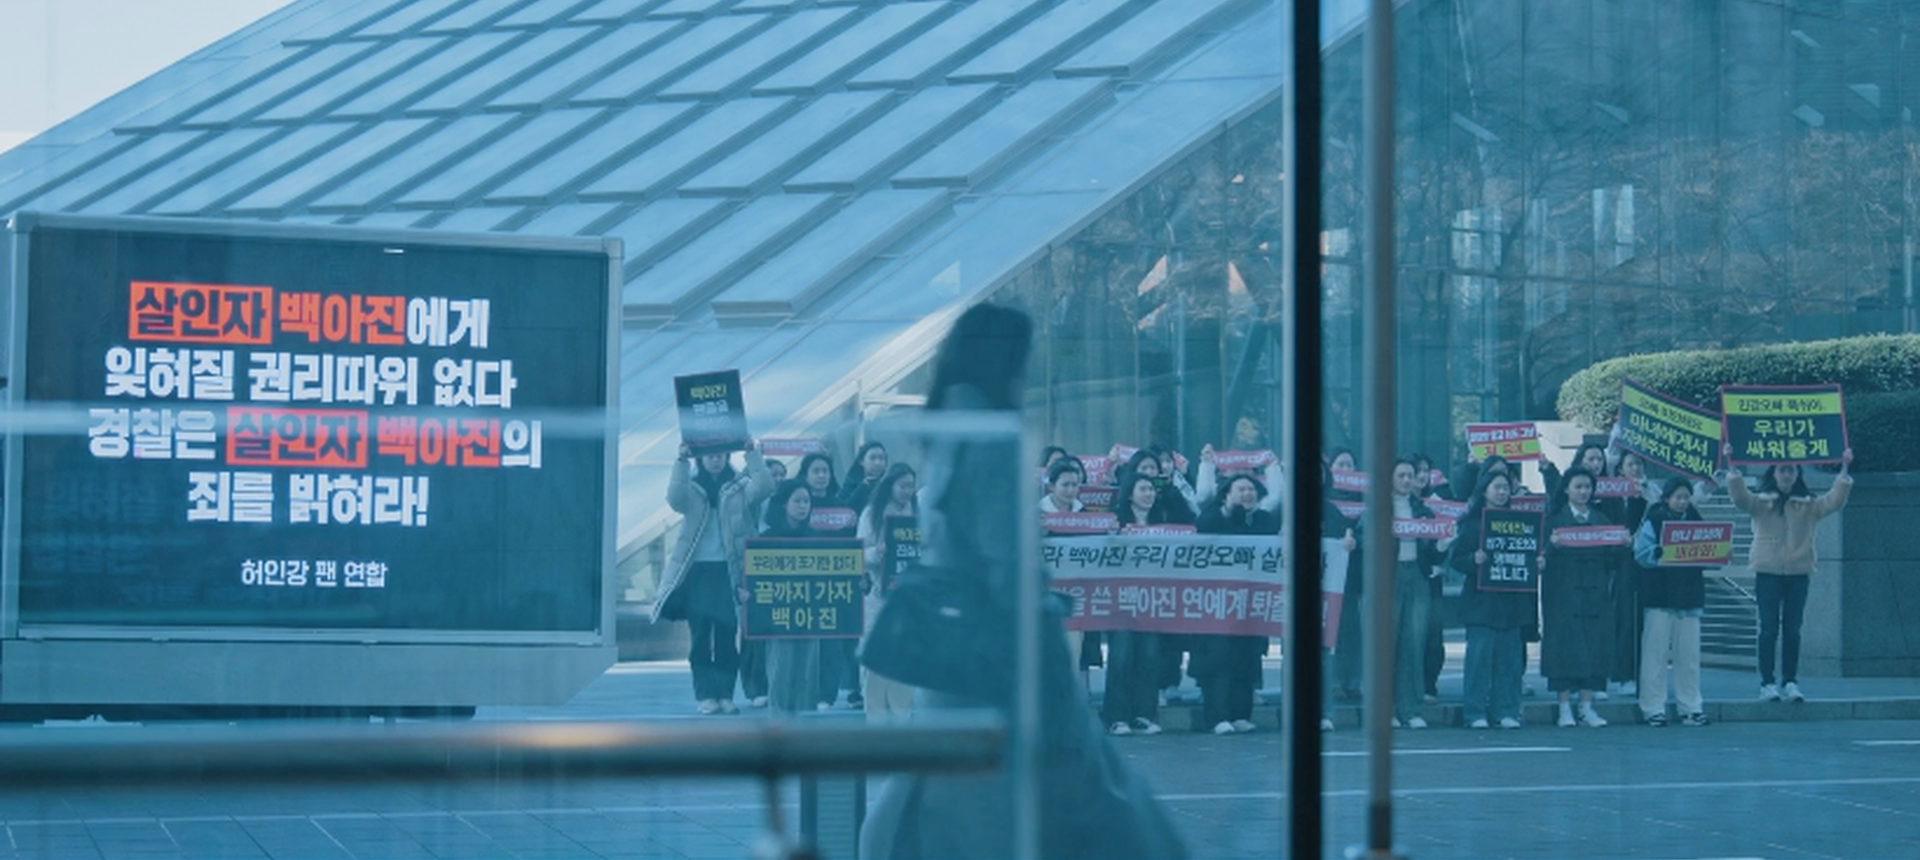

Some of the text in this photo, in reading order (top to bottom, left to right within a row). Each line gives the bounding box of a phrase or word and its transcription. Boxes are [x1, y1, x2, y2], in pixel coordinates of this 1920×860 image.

[133, 288, 490, 348] 살인자 백아진에게
[105, 347, 517, 408] 잊혀질 권리따위 없다
[88, 408, 542, 468] 경찰은 살인자 백아진의
[1628, 412, 1709, 456] 마녀에게서
[1752, 418, 1816, 438] 우리가
[1621, 427, 1716, 478] 지켜주지 못해서
[1745, 438, 1830, 459] 싸워줄게
[186, 471, 275, 522] 죄를
[289, 474, 430, 526] 밝혀라!
[241, 559, 388, 588] 허인강 팬 연합
[752, 554, 797, 571] 우리에게
[832, 554, 857, 571] 없다
[1068, 545, 1129, 569] 백아진
[1130, 546, 1170, 569] 우리
[1173, 545, 1256, 570] 인강오빠
[753, 579, 854, 604] 끝까지 가자
[1090, 585, 1112, 617] 쓴
[1117, 585, 1177, 619] 백아진
[1181, 586, 1249, 621] 연예계
